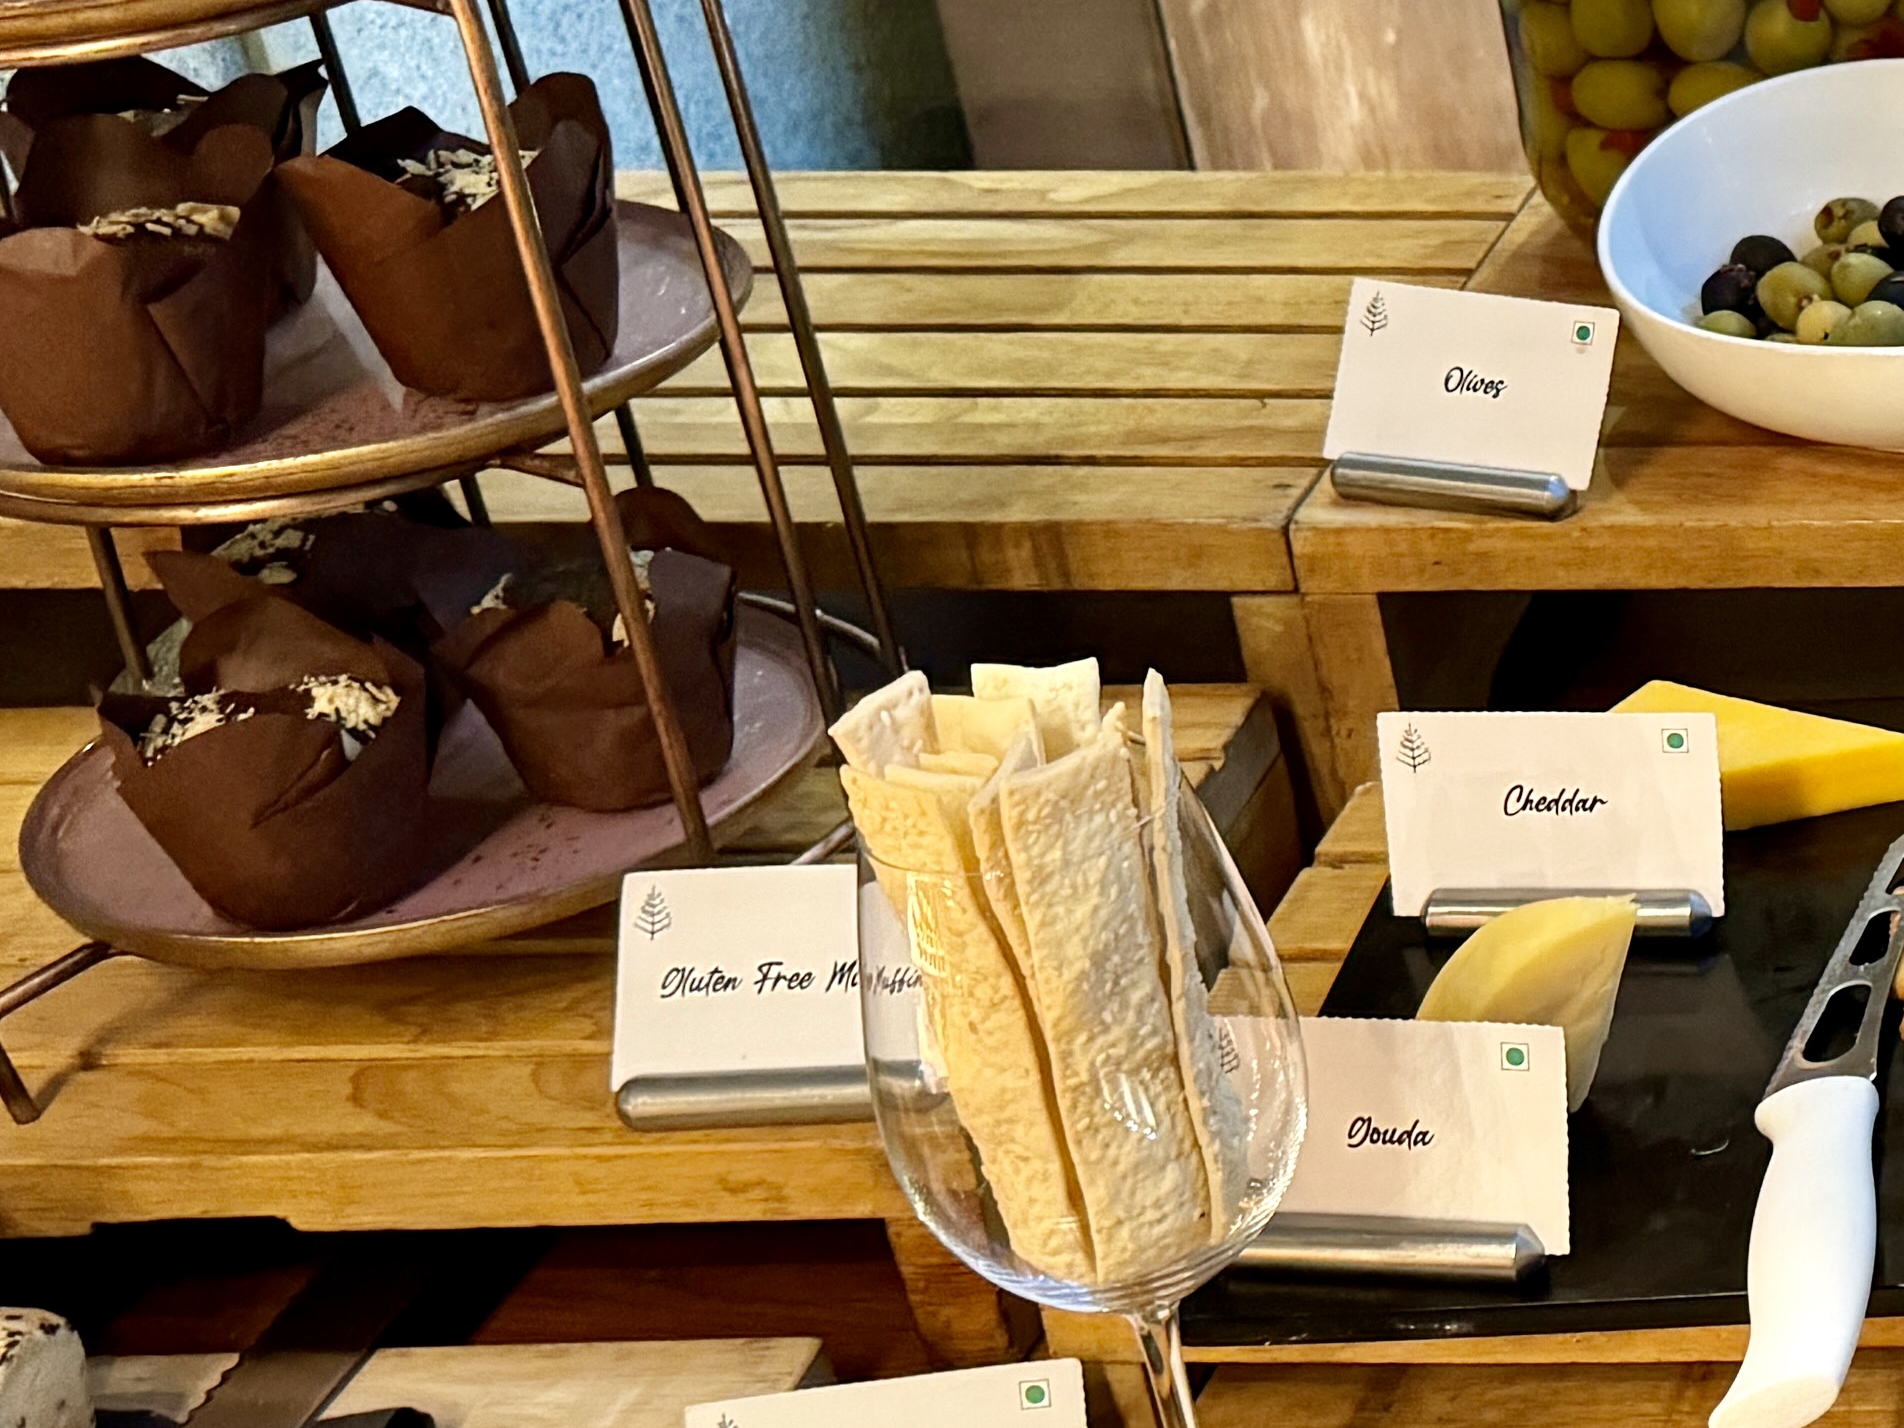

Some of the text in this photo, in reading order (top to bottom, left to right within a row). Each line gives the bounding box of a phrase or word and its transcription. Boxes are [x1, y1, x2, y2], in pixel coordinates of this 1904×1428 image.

[1443, 366, 1508, 400] Olives
[1503, 784, 1609, 817] Cheddar
[659, 965, 743, 999] Gluten
[753, 961, 816, 996] Free
[1346, 1115, 1435, 1151] Gouda
